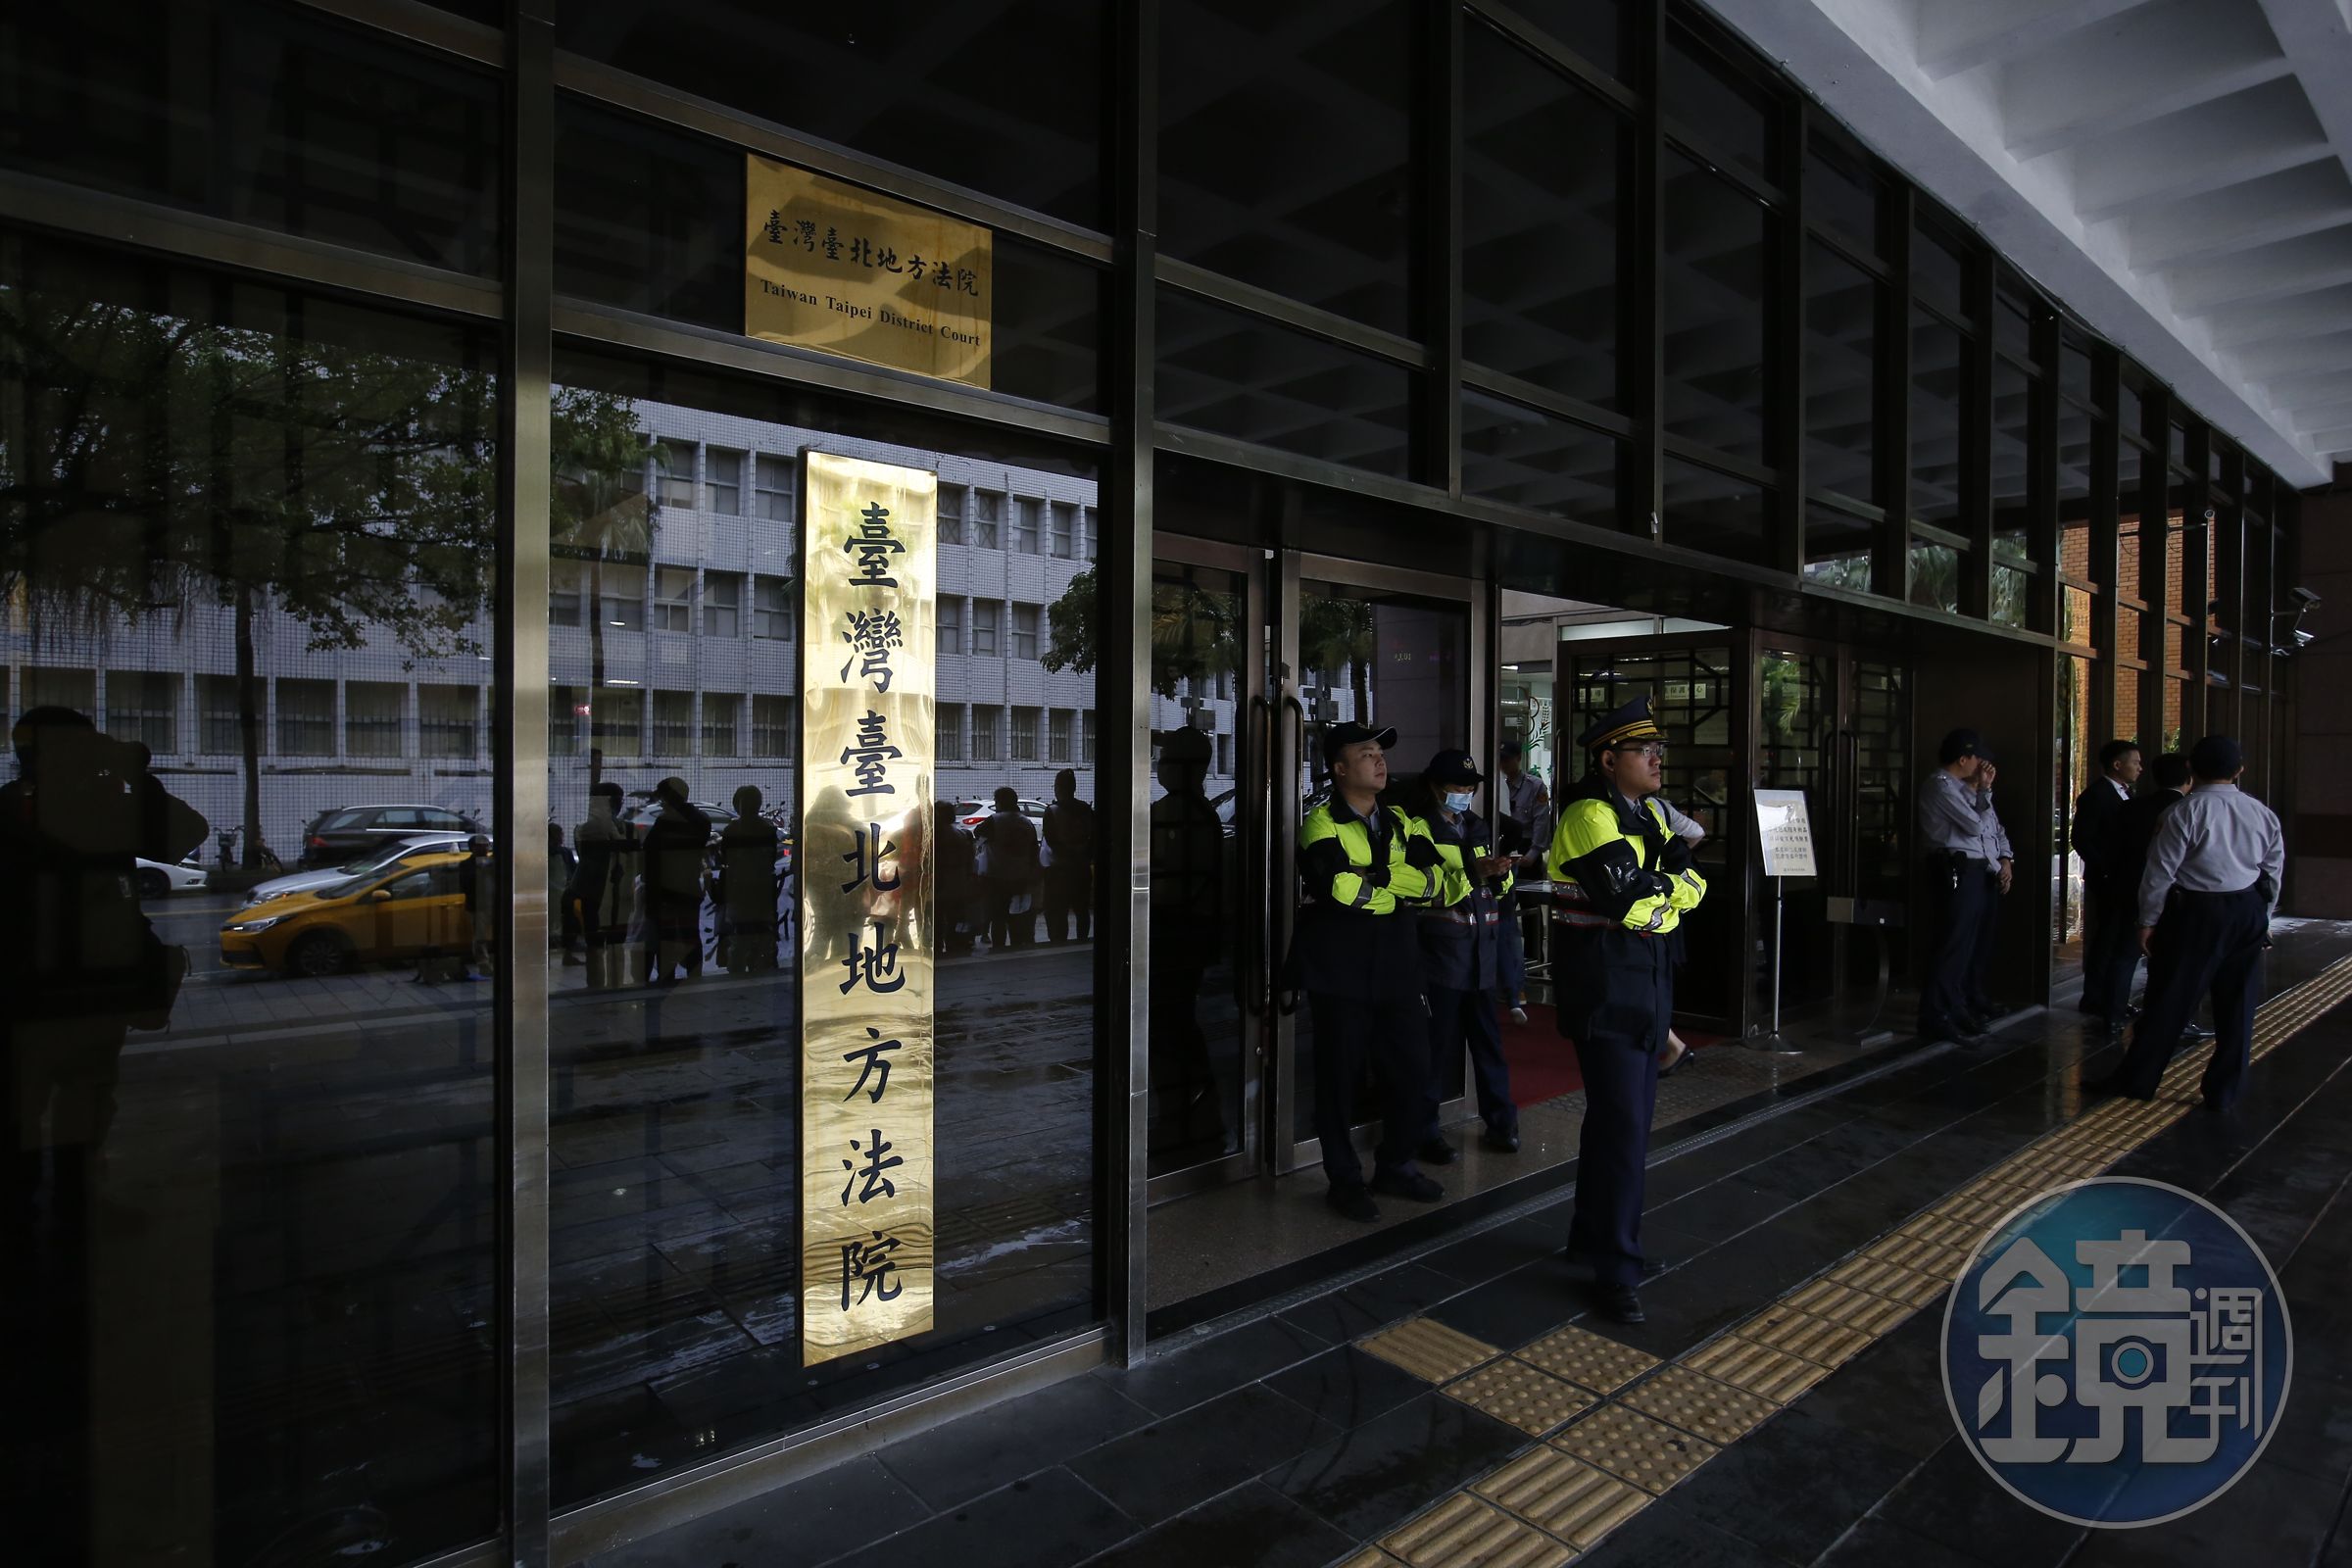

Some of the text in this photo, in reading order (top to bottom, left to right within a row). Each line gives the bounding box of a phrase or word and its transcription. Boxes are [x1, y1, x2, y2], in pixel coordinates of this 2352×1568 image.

[763, 209, 979, 297] 臺灣臺北地方法院
[760, 278, 981, 347] Taiwan Taipei District Court
[839, 501, 906, 1312] 臺灣臺北地方法院
